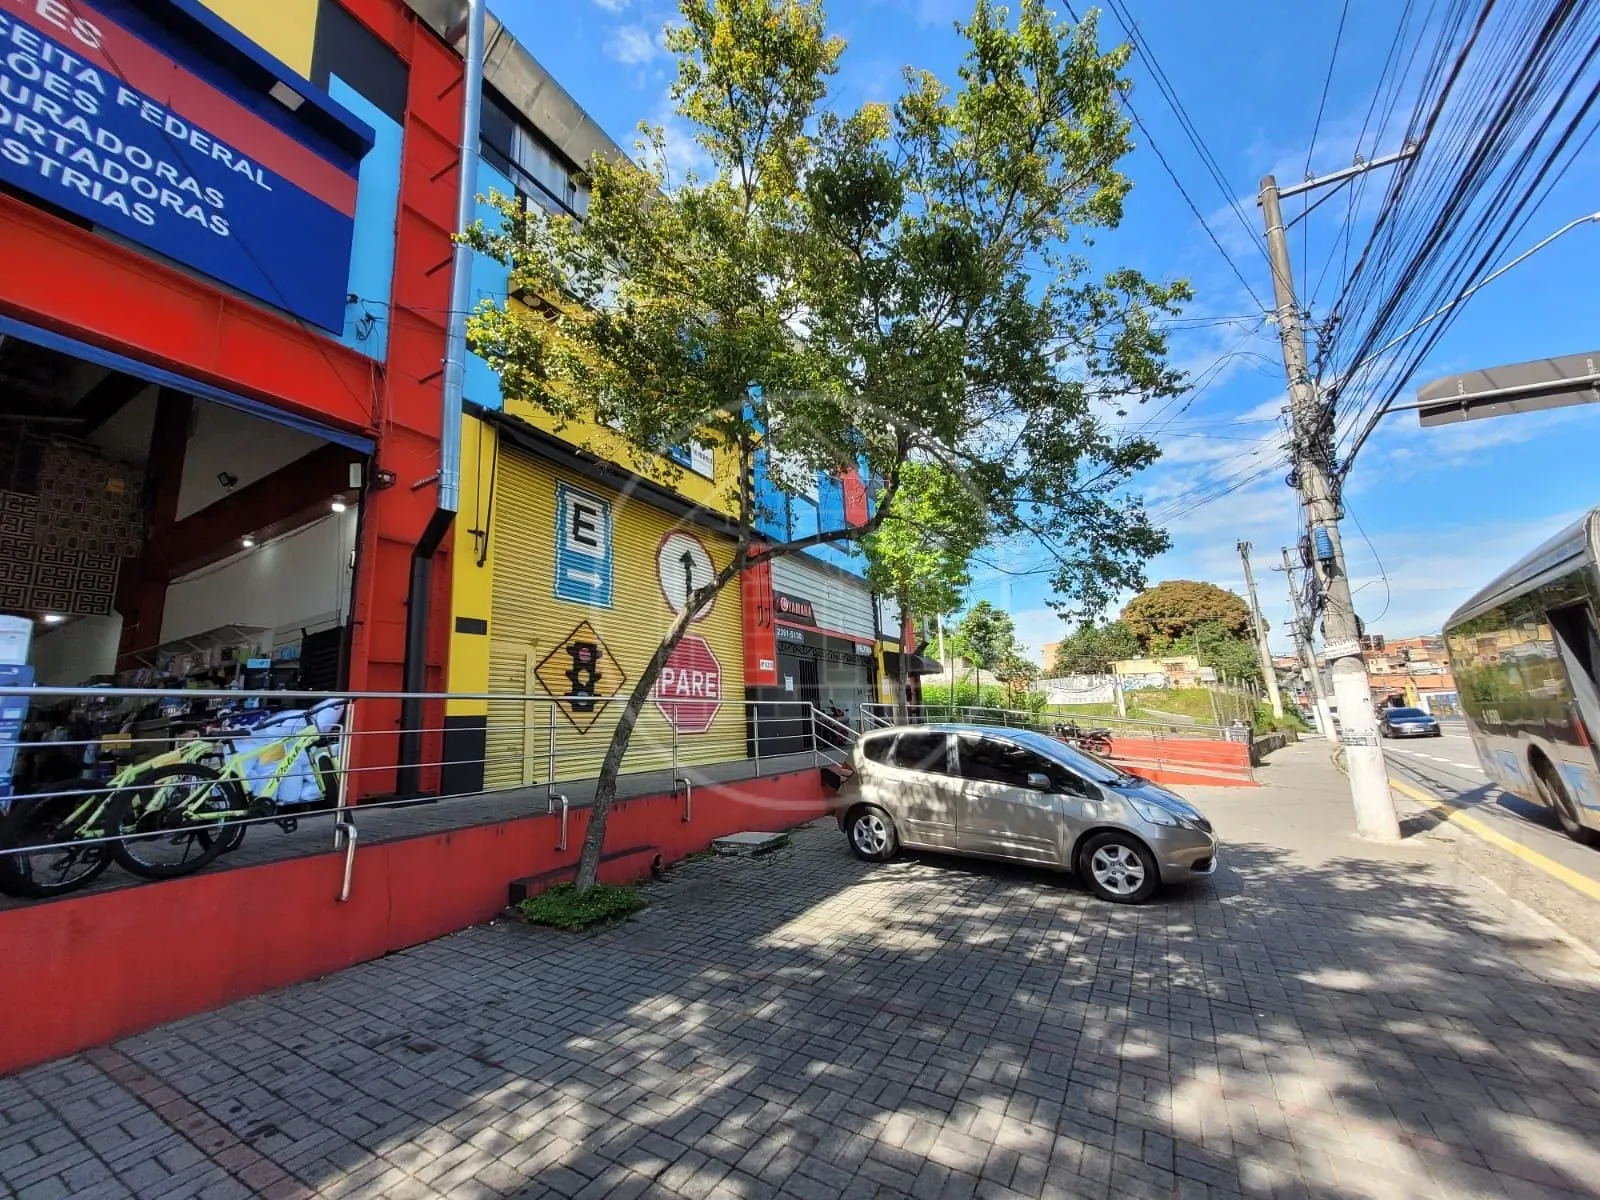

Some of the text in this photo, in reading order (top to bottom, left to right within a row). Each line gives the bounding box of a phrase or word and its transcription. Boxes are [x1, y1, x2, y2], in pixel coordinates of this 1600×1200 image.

[0, 50, 99, 116] ÕES
[116, 86, 272, 191] FEDERAL
[0, 138, 156, 226] STRIAS
[572, 502, 598, 548] E
[661, 666, 718, 698] PARE
